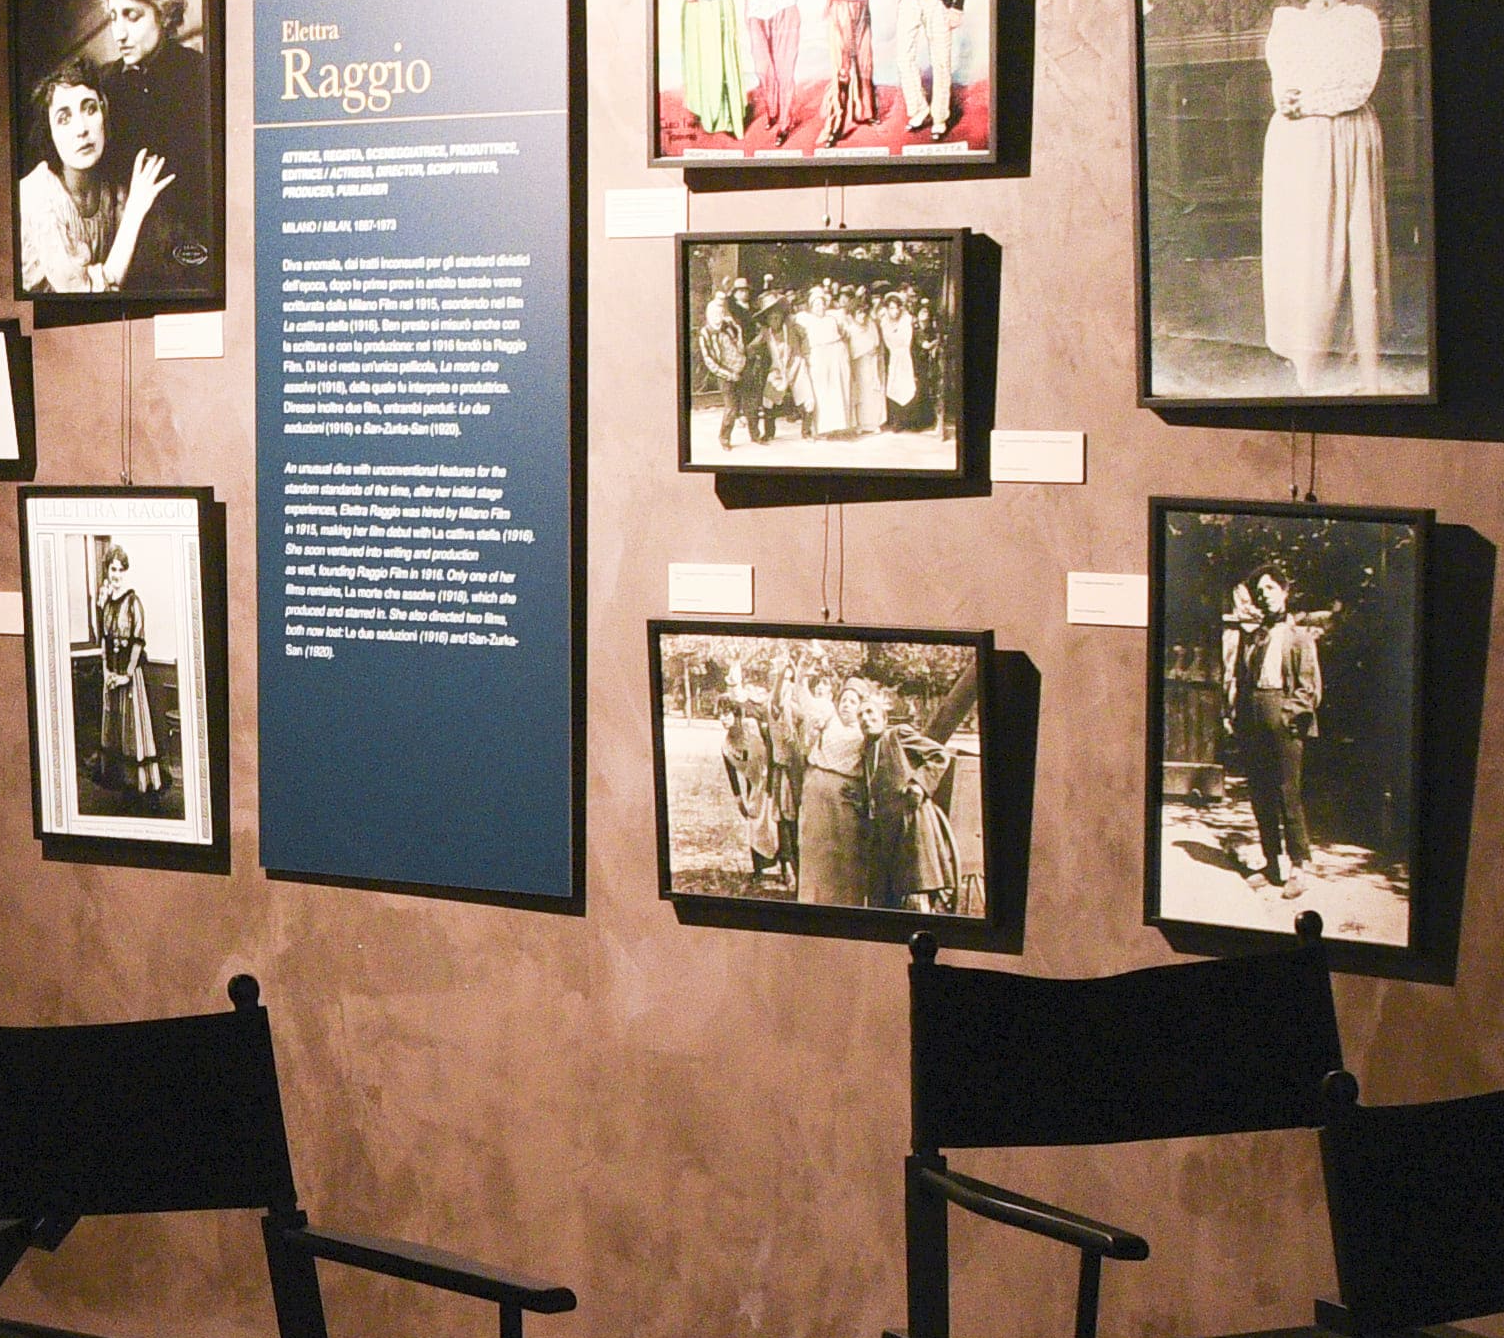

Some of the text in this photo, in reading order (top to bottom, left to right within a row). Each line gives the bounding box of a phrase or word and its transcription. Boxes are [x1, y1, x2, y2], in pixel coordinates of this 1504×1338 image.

[282, 20, 339, 42] Elettra
[281, 42, 431, 113] Raggio
[42, 500, 194, 519] ELETTRA RAGGIO
